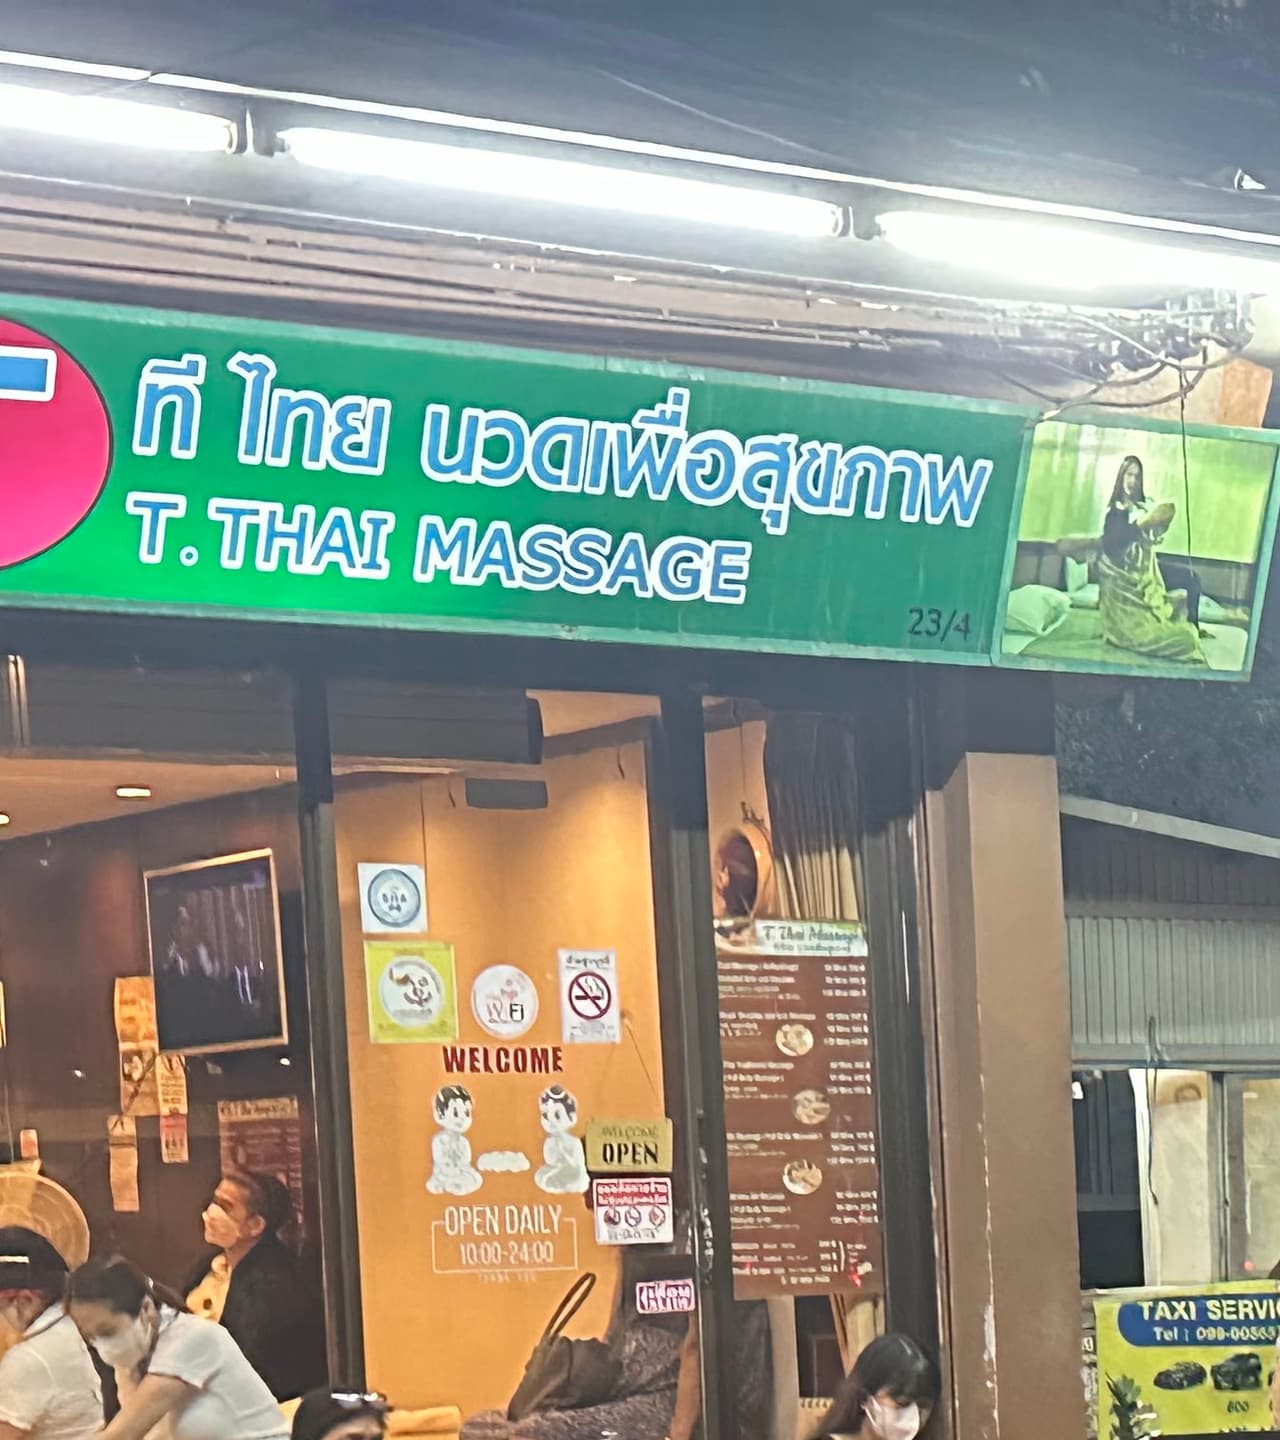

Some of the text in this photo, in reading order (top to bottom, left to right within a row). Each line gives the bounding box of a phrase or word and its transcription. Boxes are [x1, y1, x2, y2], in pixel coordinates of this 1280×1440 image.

[132, 353, 207, 460] ที
[226, 350, 392, 476] ไทย
[420, 387, 993, 536] นวดเพื่อสุขภาพ
[207, 497, 395, 580] THAI
[412, 514, 752, 606] MASSAGE
[907, 607, 972, 641] 23/4
[442, 1045, 564, 1074] WELCOME
[602, 1142, 659, 1166] OPEN
[444, 1204, 562, 1236] OPEN DAILY
[1140, 1299, 1197, 1321] TAXI
[1153, 1326, 1178, 1342] Tel
